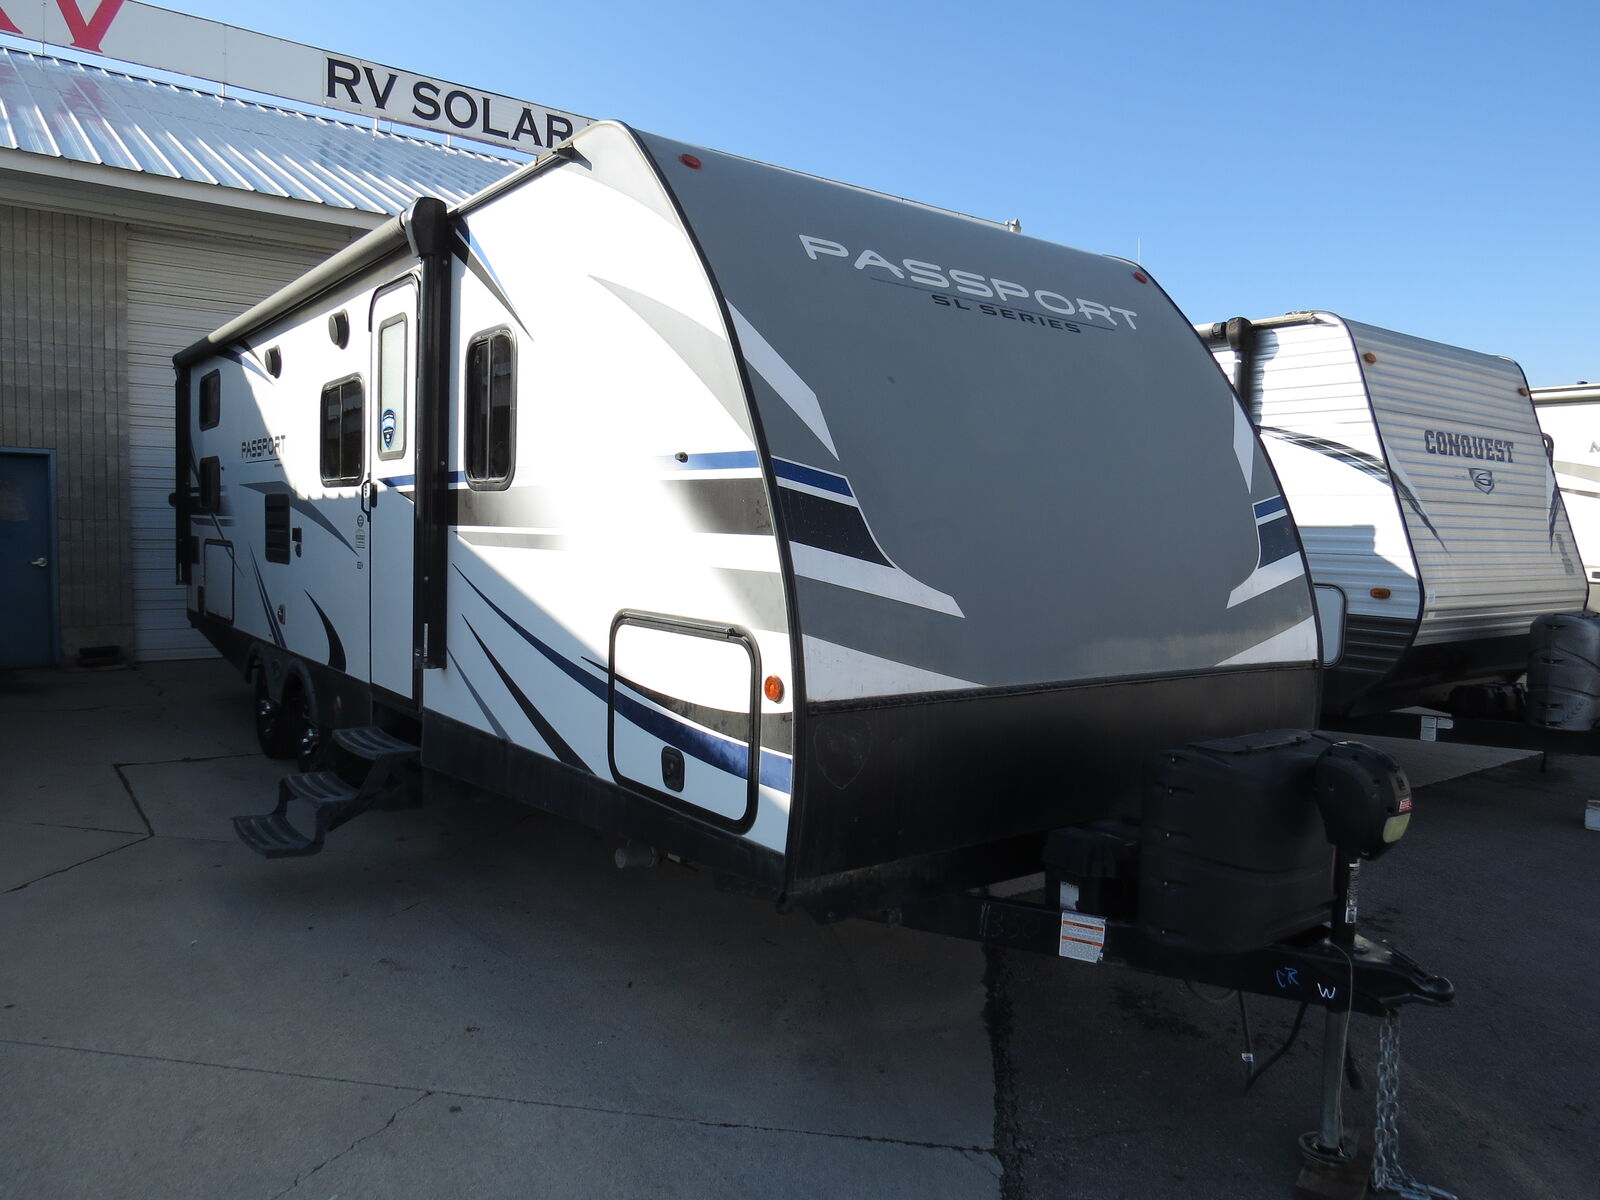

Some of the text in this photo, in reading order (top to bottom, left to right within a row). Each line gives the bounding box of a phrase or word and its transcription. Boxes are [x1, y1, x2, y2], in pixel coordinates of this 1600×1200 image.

[326, 57, 574, 148] RV SOLAR
[798, 234, 1138, 331] PASSPORT
[931, 294, 1082, 334] SL SERIES
[241, 434, 286, 459] PASSPORT
[1424, 429, 1515, 463] CONQUEST
[1316, 982, 1337, 1000] W
